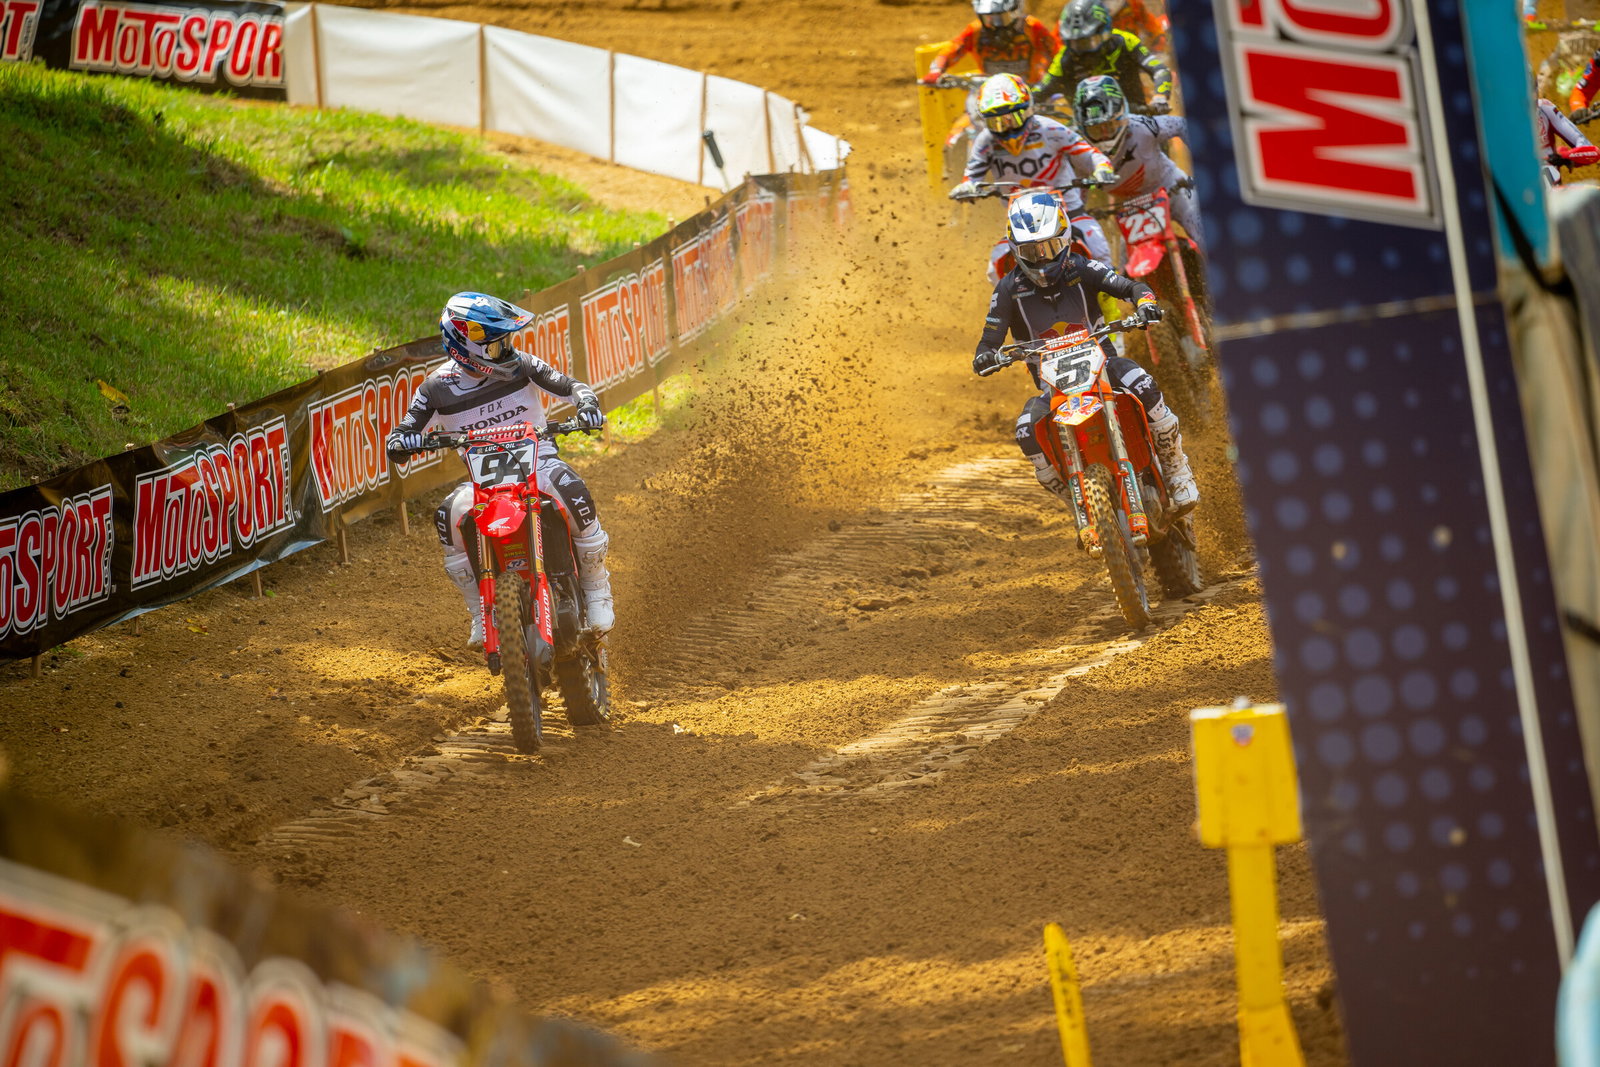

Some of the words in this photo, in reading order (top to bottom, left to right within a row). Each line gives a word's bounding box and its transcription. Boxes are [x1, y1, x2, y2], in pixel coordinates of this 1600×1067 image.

[77, 6, 281, 78] MOTOSPOR
[1125, 206, 1166, 243] 23
[1055, 350, 1092, 392] 5
[459, 405, 529, 432] HONDA
[479, 399, 503, 416] FOX
[471, 423, 526, 436] RENTHAL
[480, 450, 532, 490] 94
[133, 422, 285, 586] MOTOSPORT
[542, 588, 552, 636] DUNLOP
